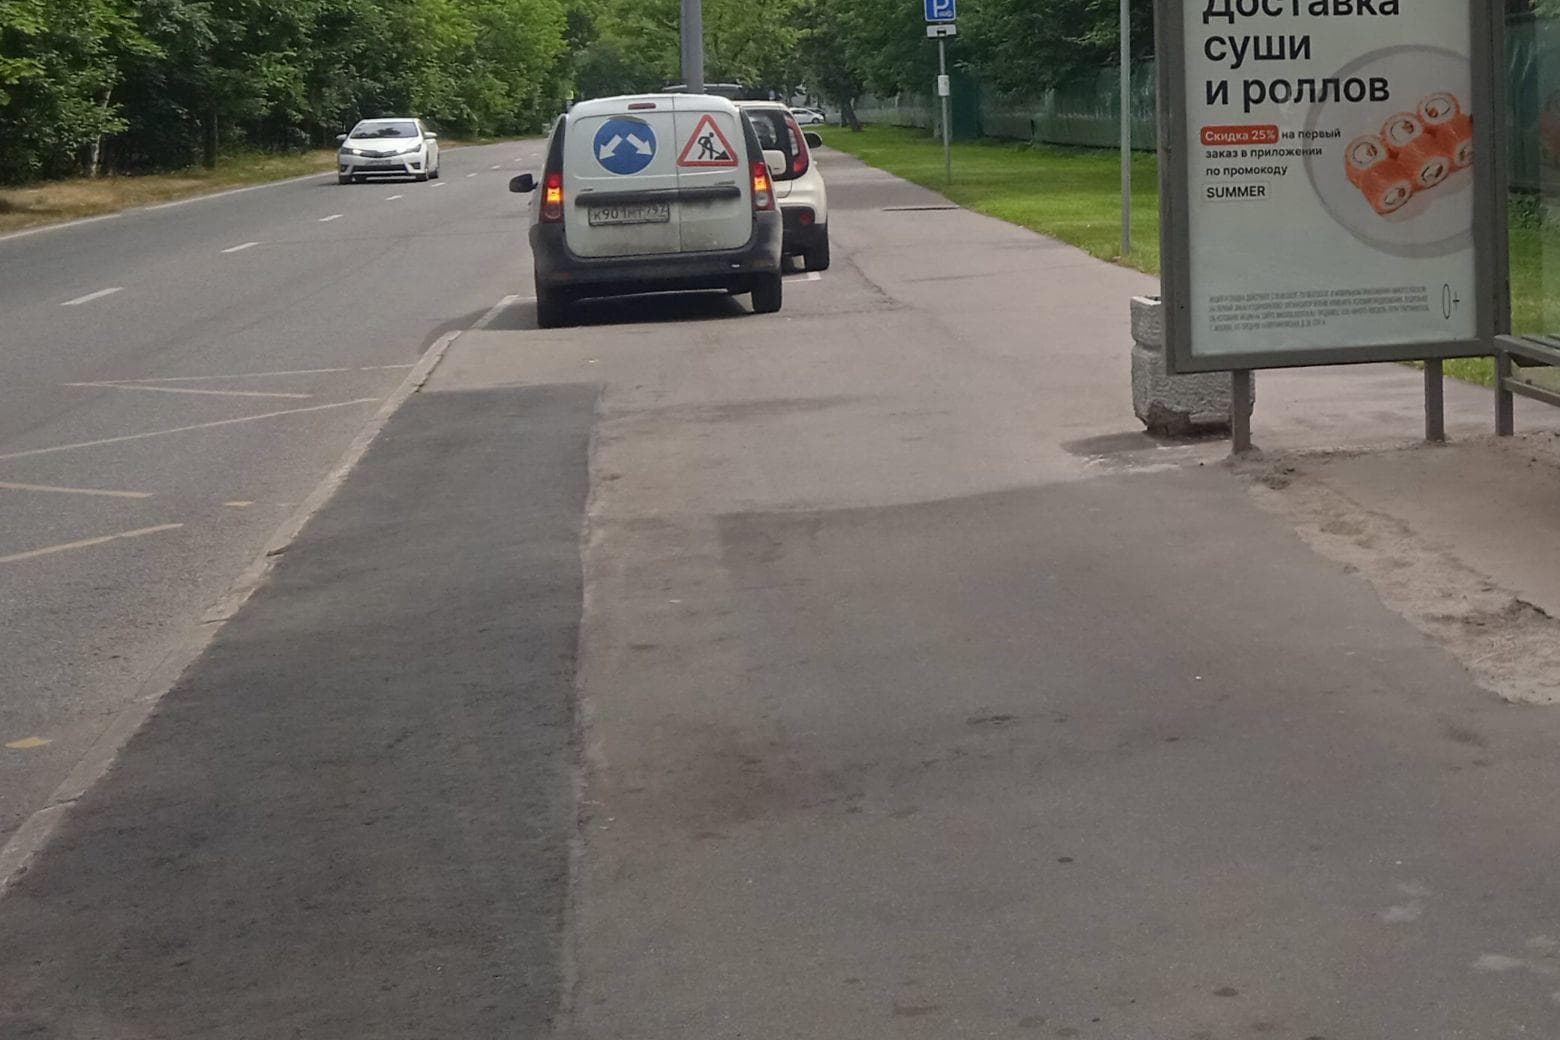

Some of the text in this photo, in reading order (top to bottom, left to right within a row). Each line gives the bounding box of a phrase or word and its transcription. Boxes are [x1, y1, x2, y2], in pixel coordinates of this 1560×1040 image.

[1203, 34, 1312, 69] суши
[1205, 76, 1390, 114] и роллов
[1204, 128, 1342, 142] Скидка 25% на первый
[1205, 147, 1323, 160] заказ в приложении
[1206, 164, 1288, 178] по промокоду
[1206, 185, 1266, 199] SUMMER
